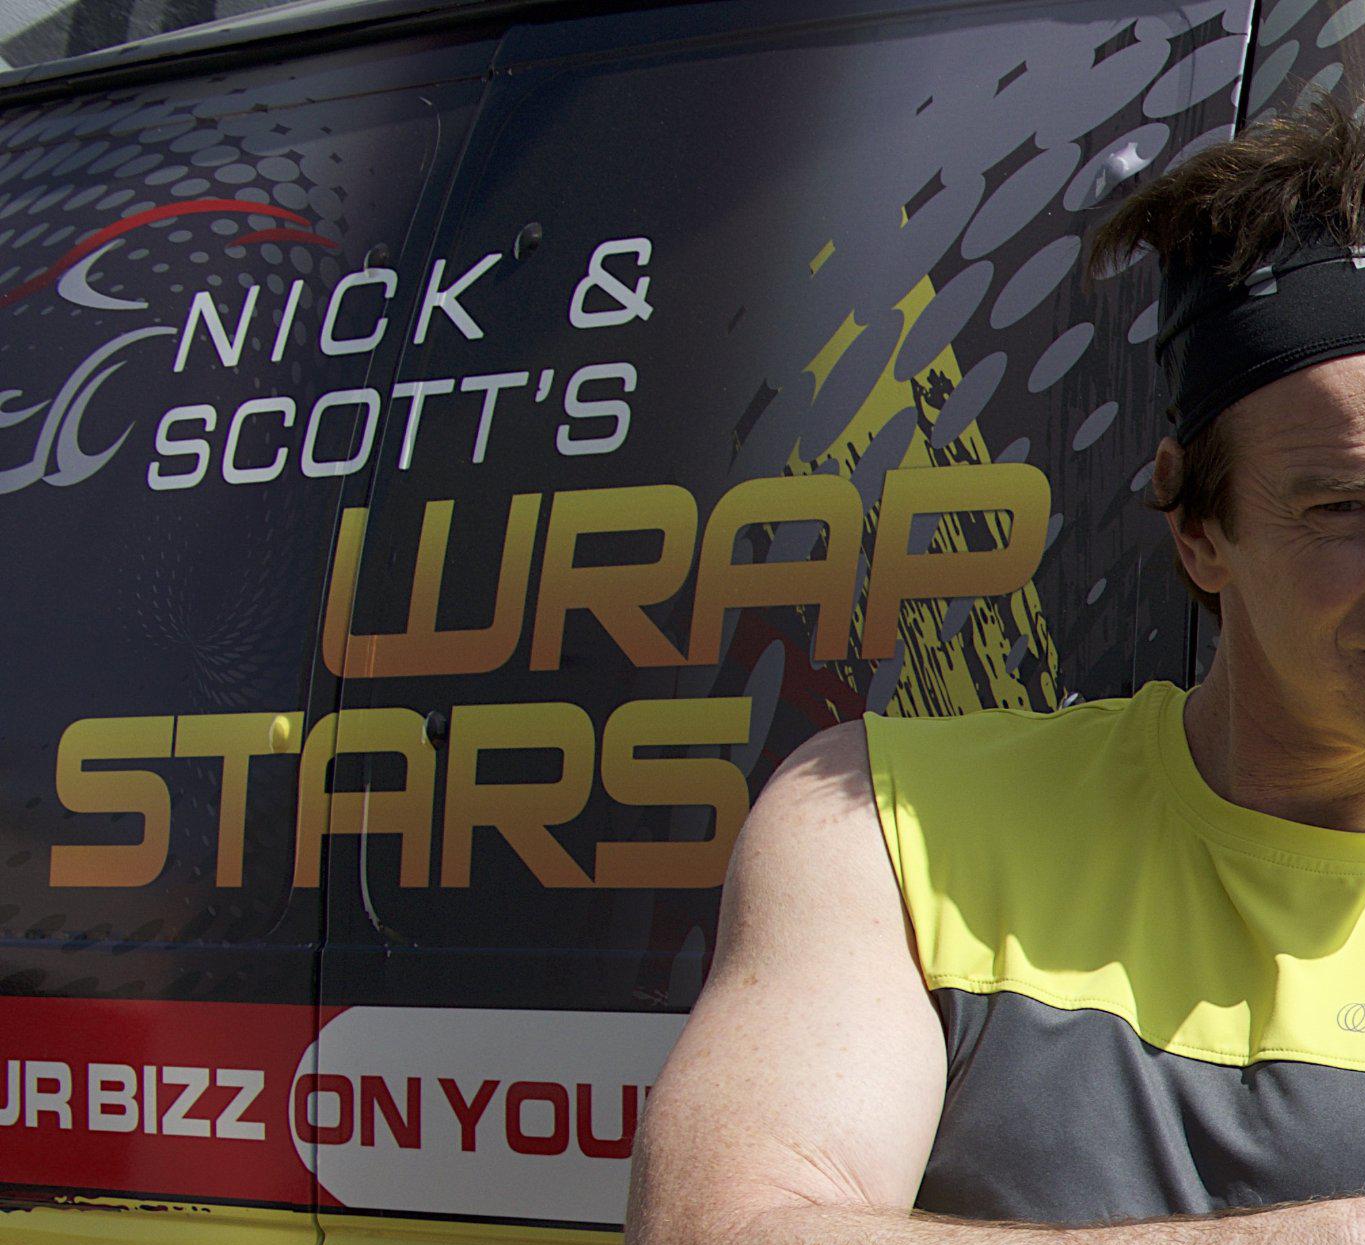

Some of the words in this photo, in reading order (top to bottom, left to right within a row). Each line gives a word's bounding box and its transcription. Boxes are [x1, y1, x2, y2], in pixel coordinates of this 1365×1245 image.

[172, 252, 502, 373] NICK
[569, 236, 655, 330] &
[147, 361, 639, 492] SCOTT'S
[320, 463, 1052, 680] WRAP
[49, 695, 753, 889] STARS
[87, 1063, 267, 1142] BIZZ
[293, 1073, 422, 1150] ON
[438, 1078, 654, 1161] YOU
